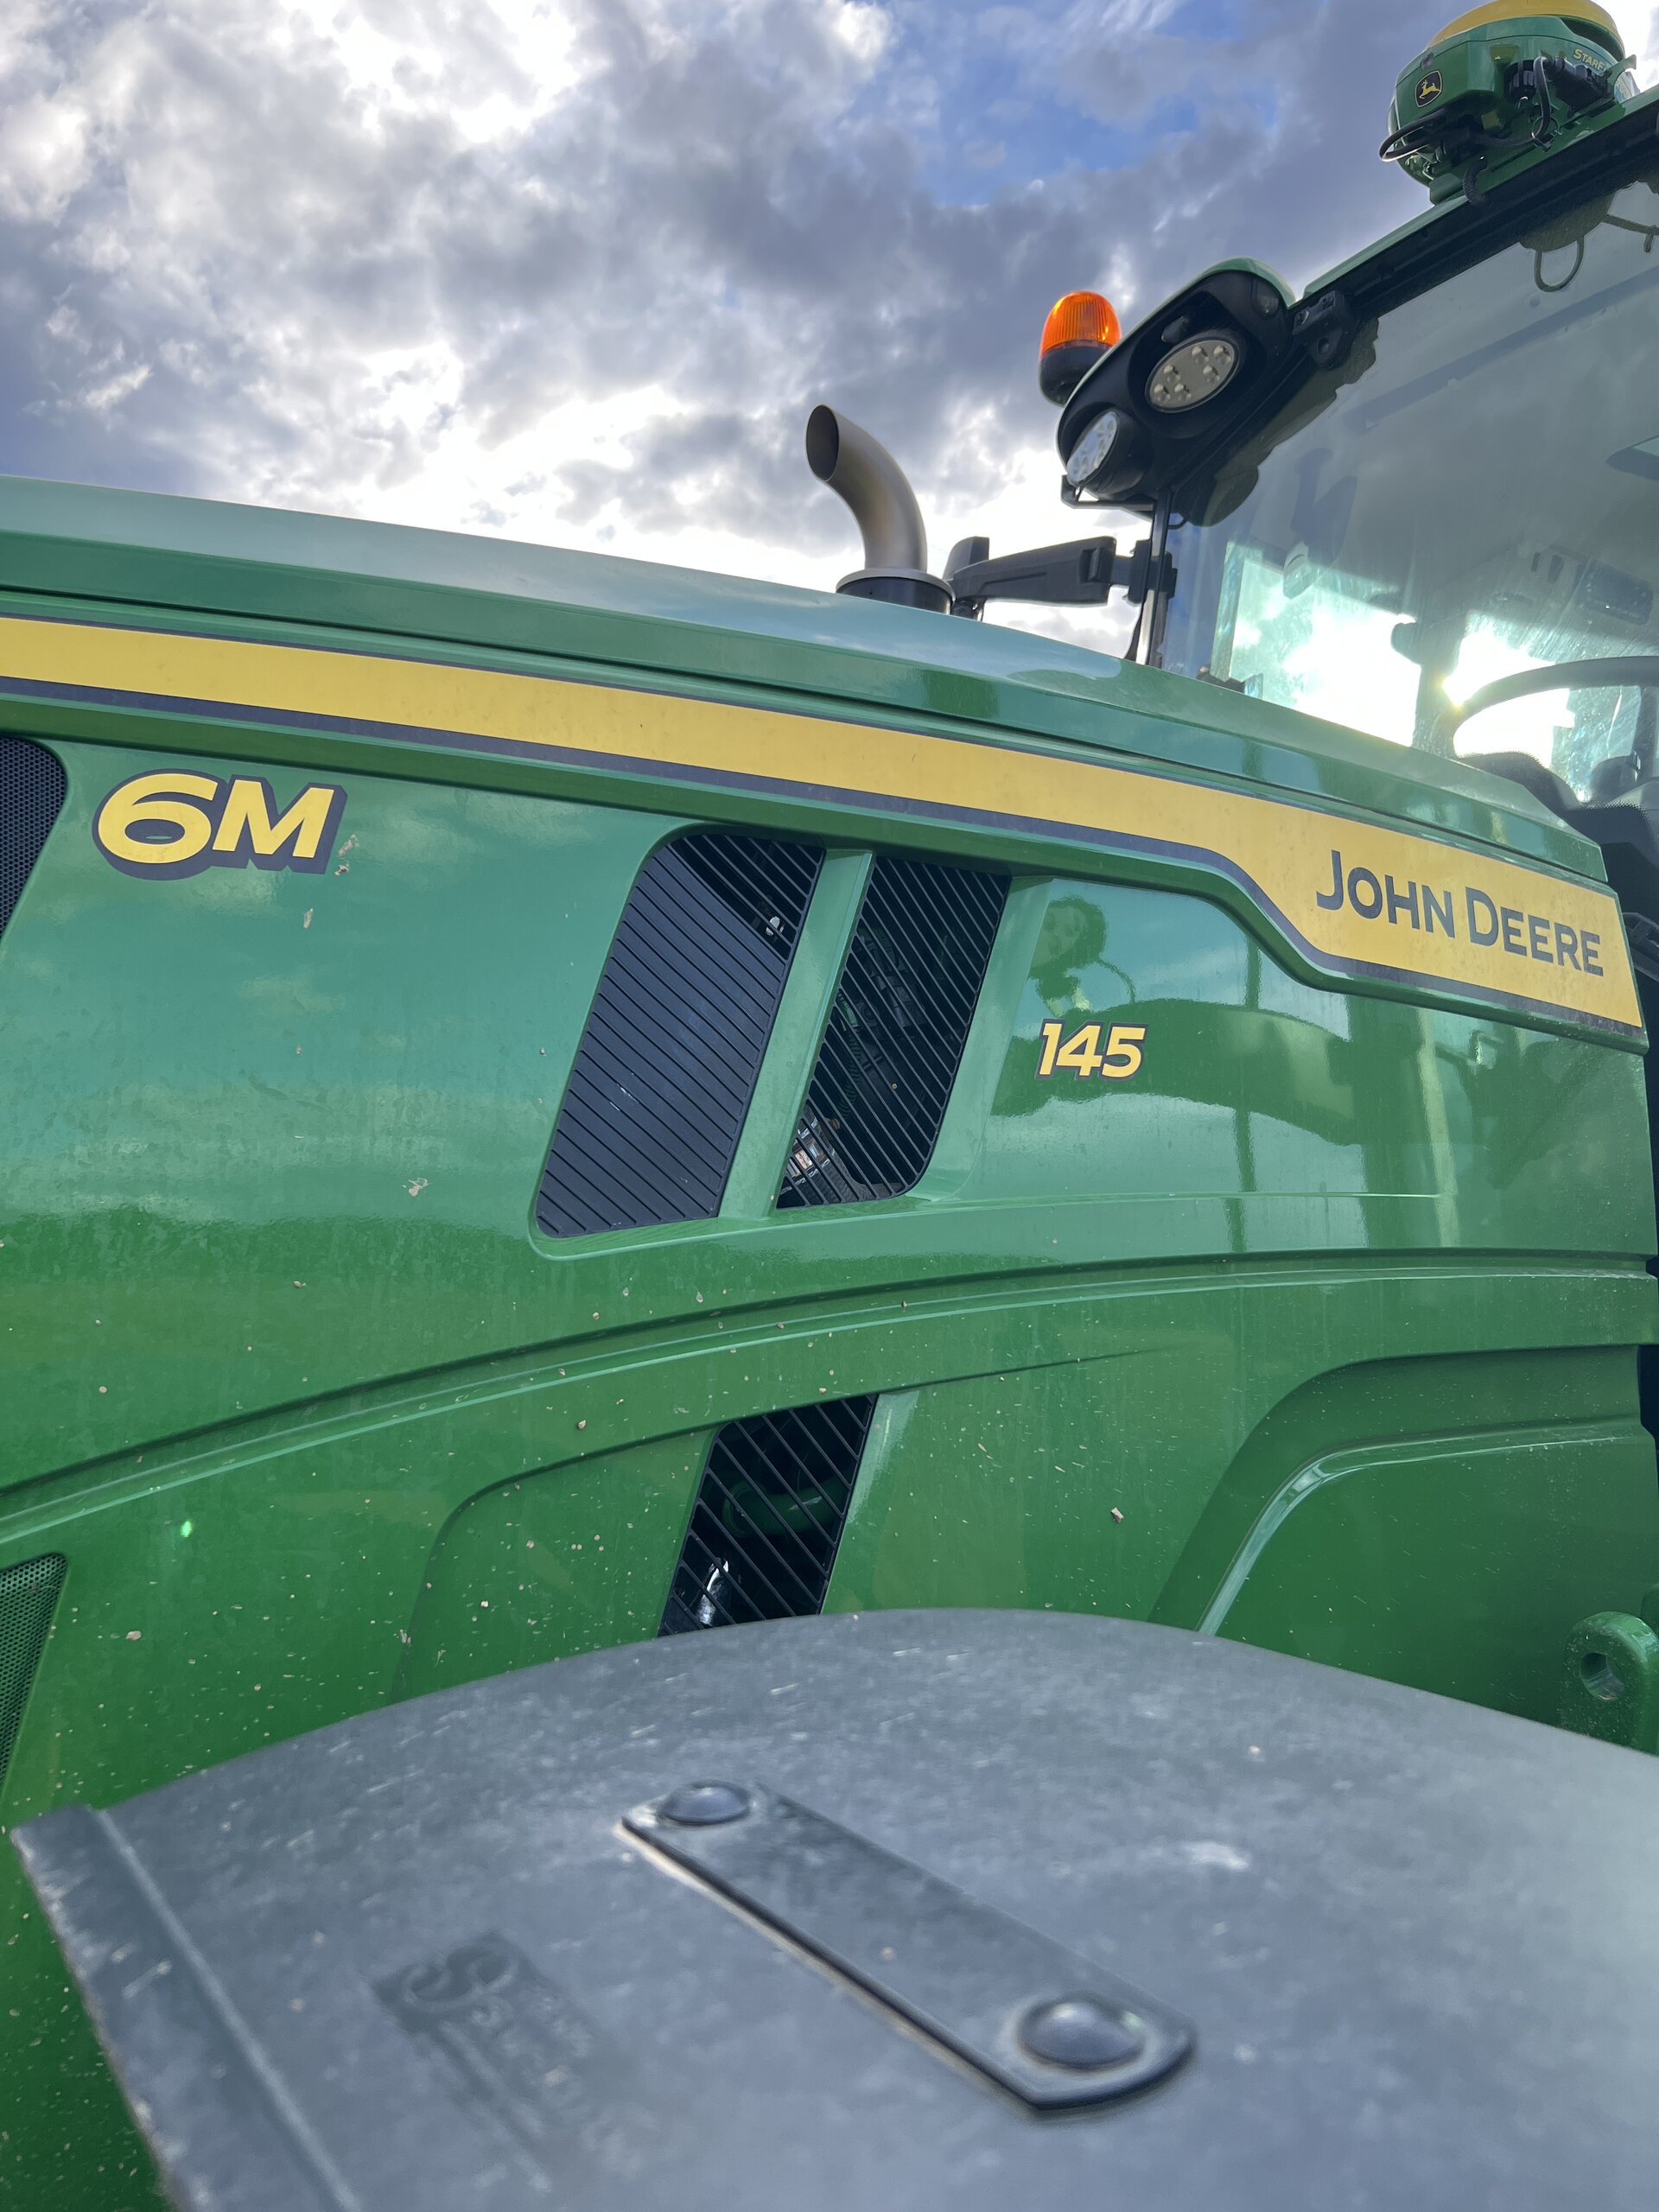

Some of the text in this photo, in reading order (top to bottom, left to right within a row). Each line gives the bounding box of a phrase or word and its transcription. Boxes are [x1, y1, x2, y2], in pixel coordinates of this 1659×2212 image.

[92, 768, 347, 881] 6M
[1316, 849, 1604, 976] JOHN DEERE
[1035, 1019, 1148, 1083] 145
